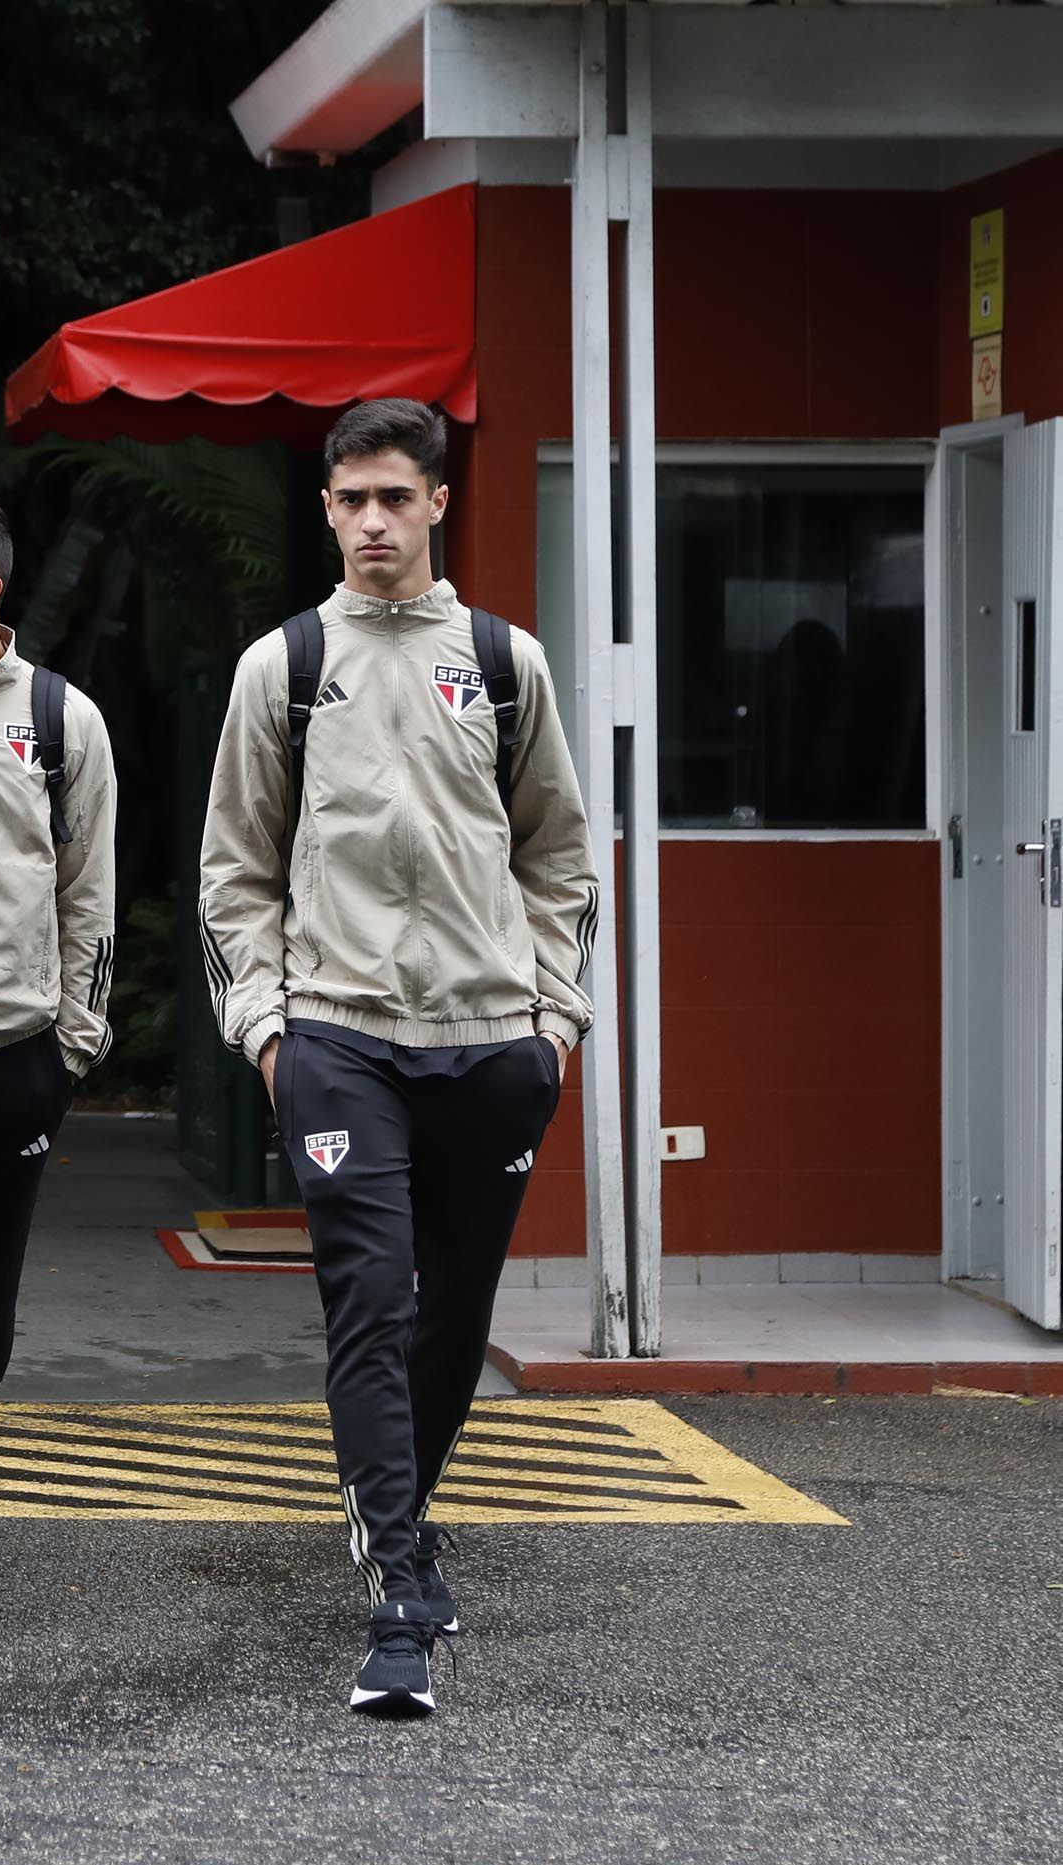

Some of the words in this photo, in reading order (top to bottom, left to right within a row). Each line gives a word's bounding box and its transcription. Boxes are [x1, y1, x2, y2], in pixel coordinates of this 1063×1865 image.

[436, 667, 481, 686] SPFC
[8, 727, 37, 740] SPF
[308, 1134, 345, 1149] SPFC
